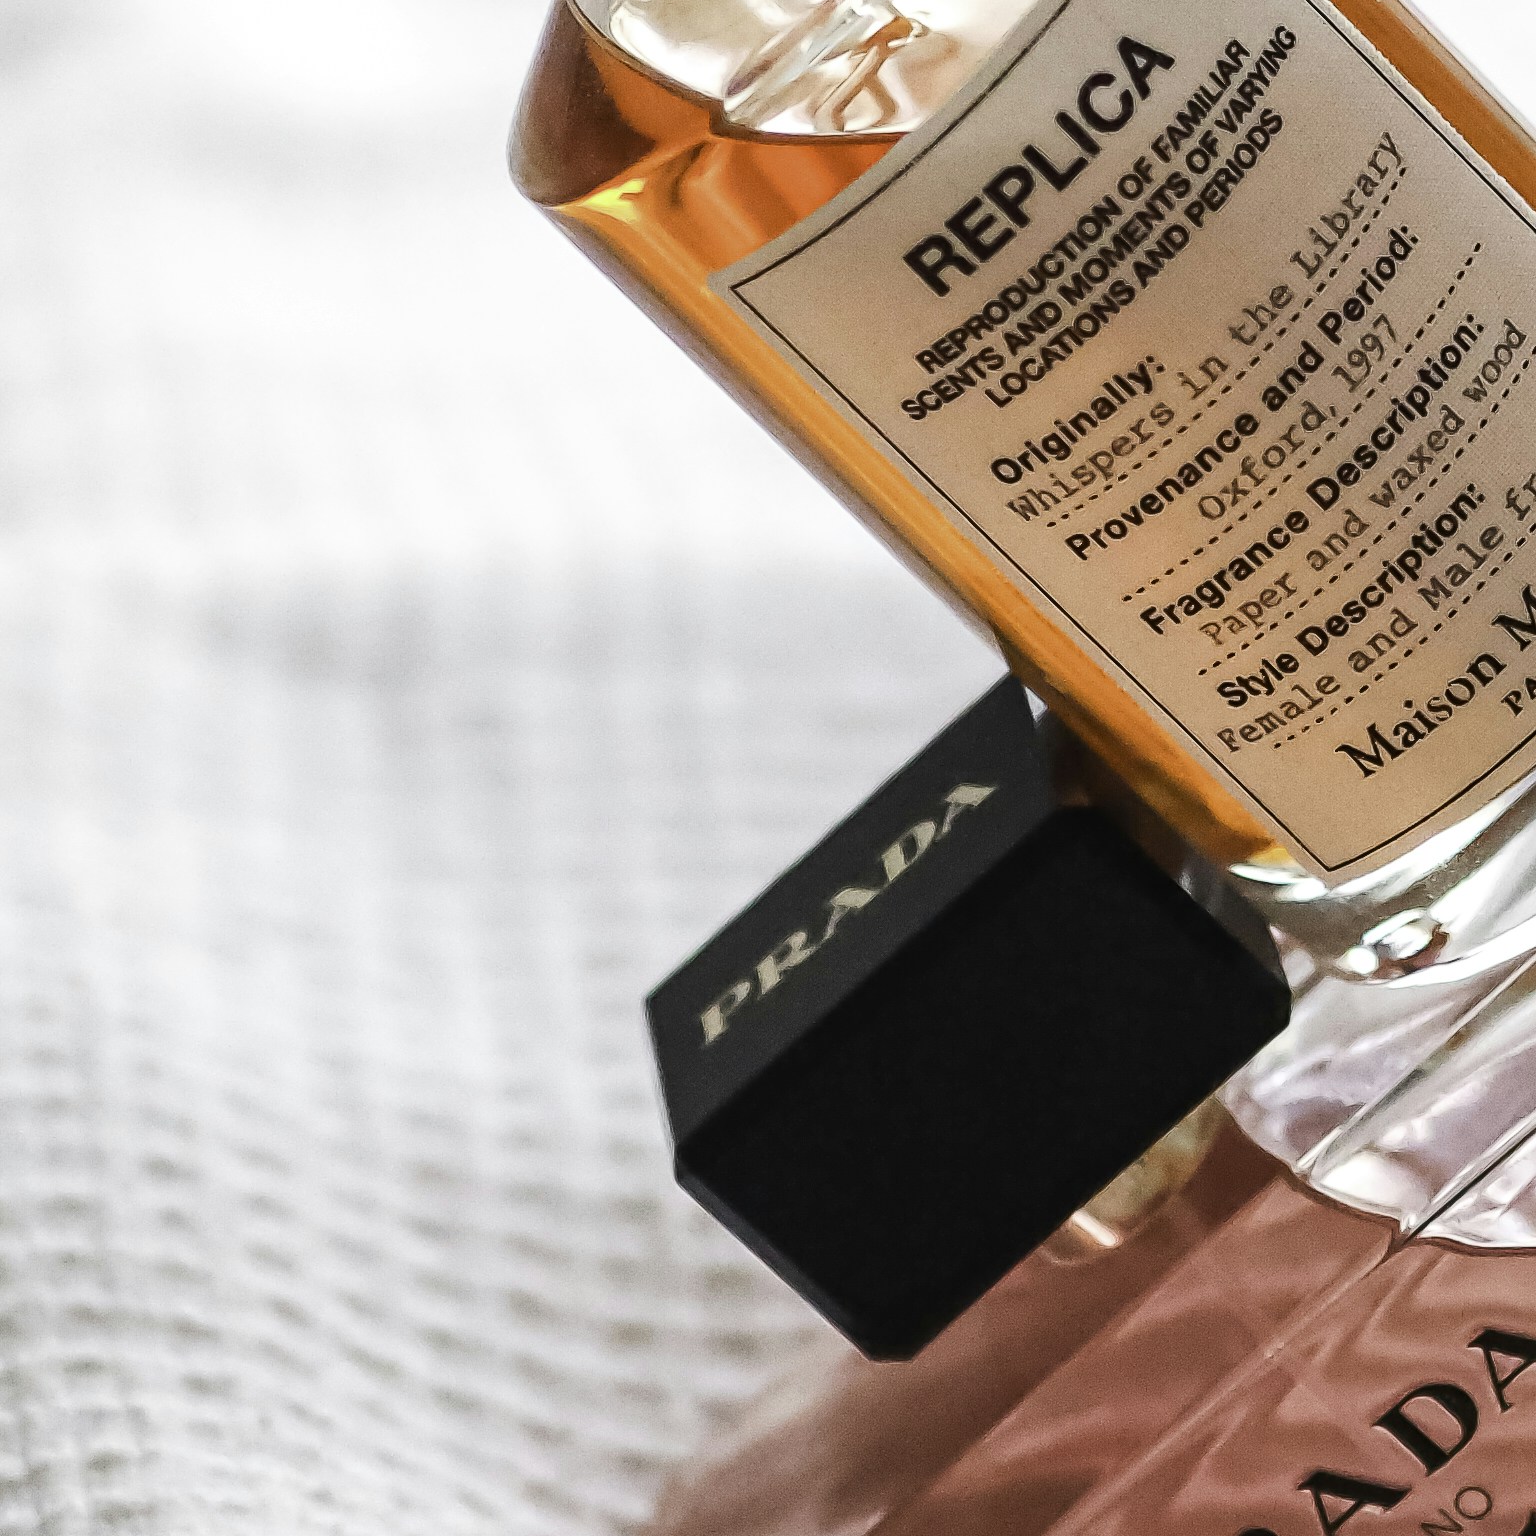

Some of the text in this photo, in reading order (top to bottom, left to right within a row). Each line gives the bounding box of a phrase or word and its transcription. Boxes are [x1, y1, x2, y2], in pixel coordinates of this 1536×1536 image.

[901, 25, 1297, 420] SCENTS AND MOMENTS OF VARYING
[902, 36, 1176, 298] REPLICA
[914, 38, 1251, 374] REPRODUCTION OF FAMILIAR
[984, 108, 1283, 408] LOCATIONS AND PERIODS
[991, 355, 1165, 485] Originally:
[1006, 131, 1402, 522] Whispers in the Library
[1064, 225, 1419, 560] Provenance and Period:
[1198, 313, 1398, 521] Oxford, 1997
[1140, 313, 1485, 634] Fragrance Description:
[1200, 319, 1527, 646] Paper and waxed wood
[1217, 483, 1486, 708] Style Description:
[1217, 674, 1341, 753] Female
[1347, 608, 1418, 675] and
[1417, 522, 1504, 611] Male
[1334, 648, 1507, 778] Maison
[701, 783, 997, 1046] PRADA
